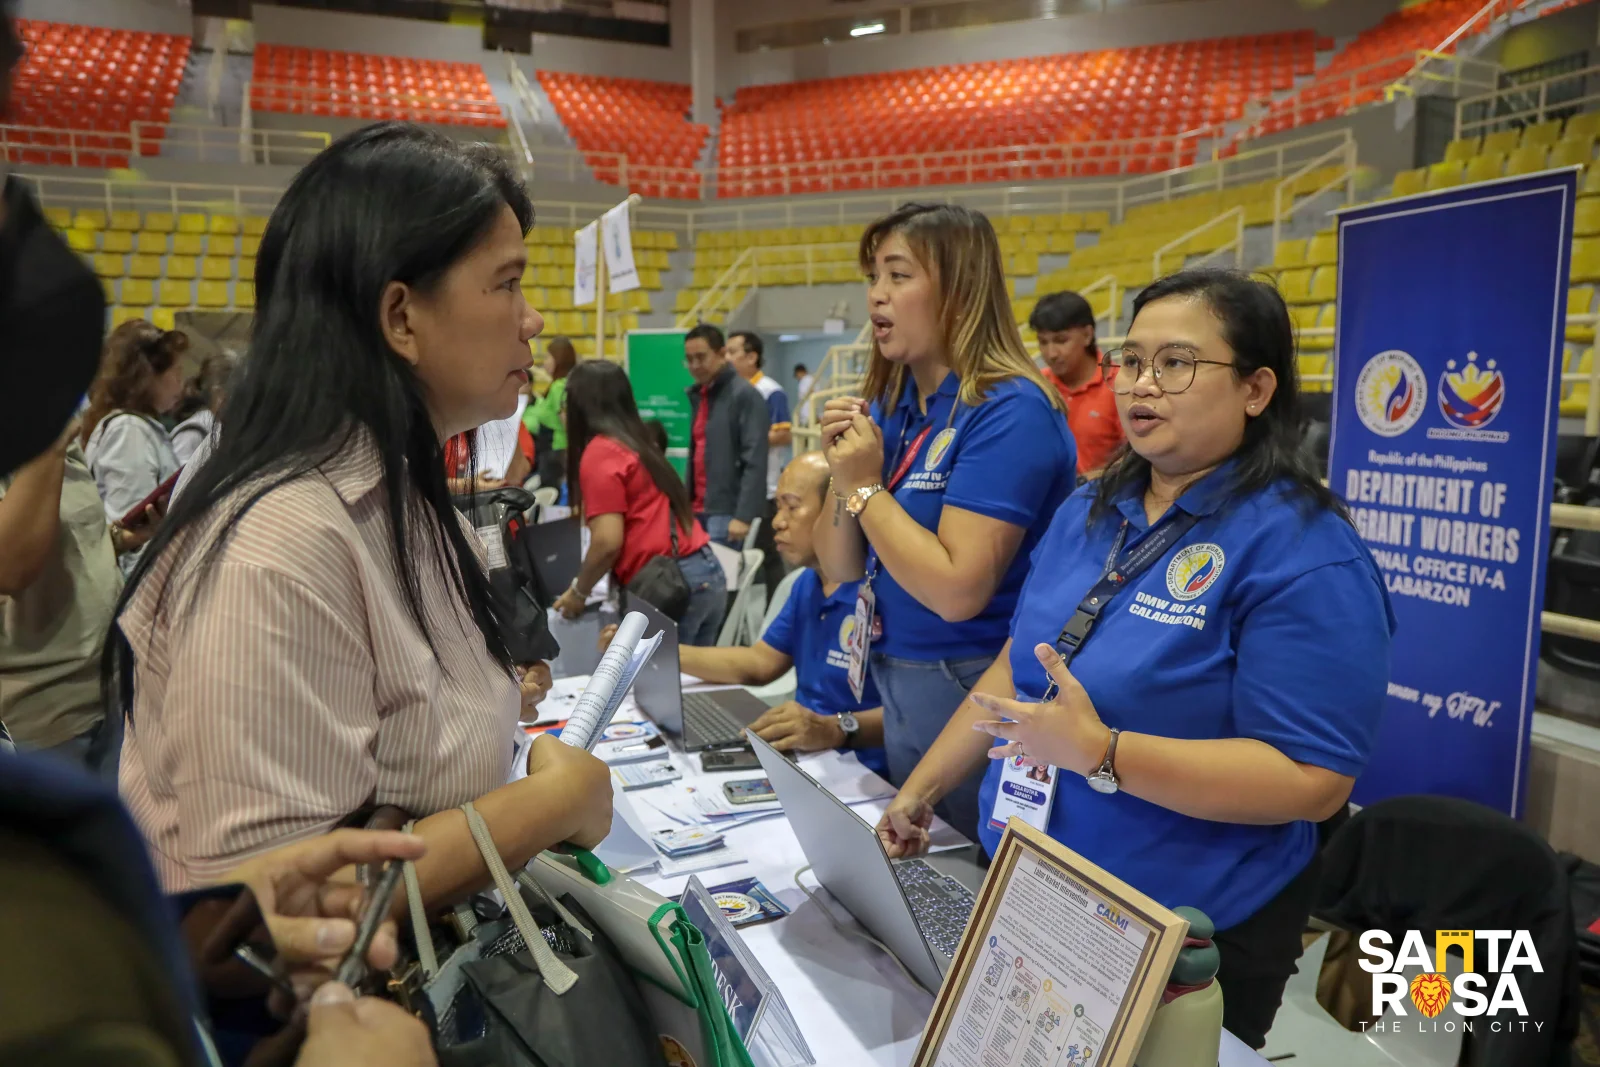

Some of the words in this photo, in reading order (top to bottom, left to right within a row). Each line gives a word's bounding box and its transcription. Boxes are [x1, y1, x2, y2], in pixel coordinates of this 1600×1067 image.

[1368, 450, 1404, 466] Republic
[1405, 453, 1417, 466] of
[1418, 453, 1432, 468] the
[1433, 454, 1488, 473] Philippines
[1346, 469, 1474, 514] DEPARTMENT
[1479, 482, 1507, 518] OF
[1349, 507, 1415, 546] IGRANT
[1421, 515, 1520, 564] WORKERS
[1168, 546, 1194, 585] DEPARTMENT
[1413, 556, 1468, 582] OFFICE
[1469, 565, 1505, 590] IV-A
[1136, 592, 1170, 610] DMW
[1169, 603, 1186, 613] RO
[1384, 574, 1470, 607] LABARZON
[1034, 867, 1045, 879] Labor
[1045, 874, 1060, 889] Market
[1059, 883, 1088, 908] Interventions
[1097, 903, 1128, 930] CALMI
